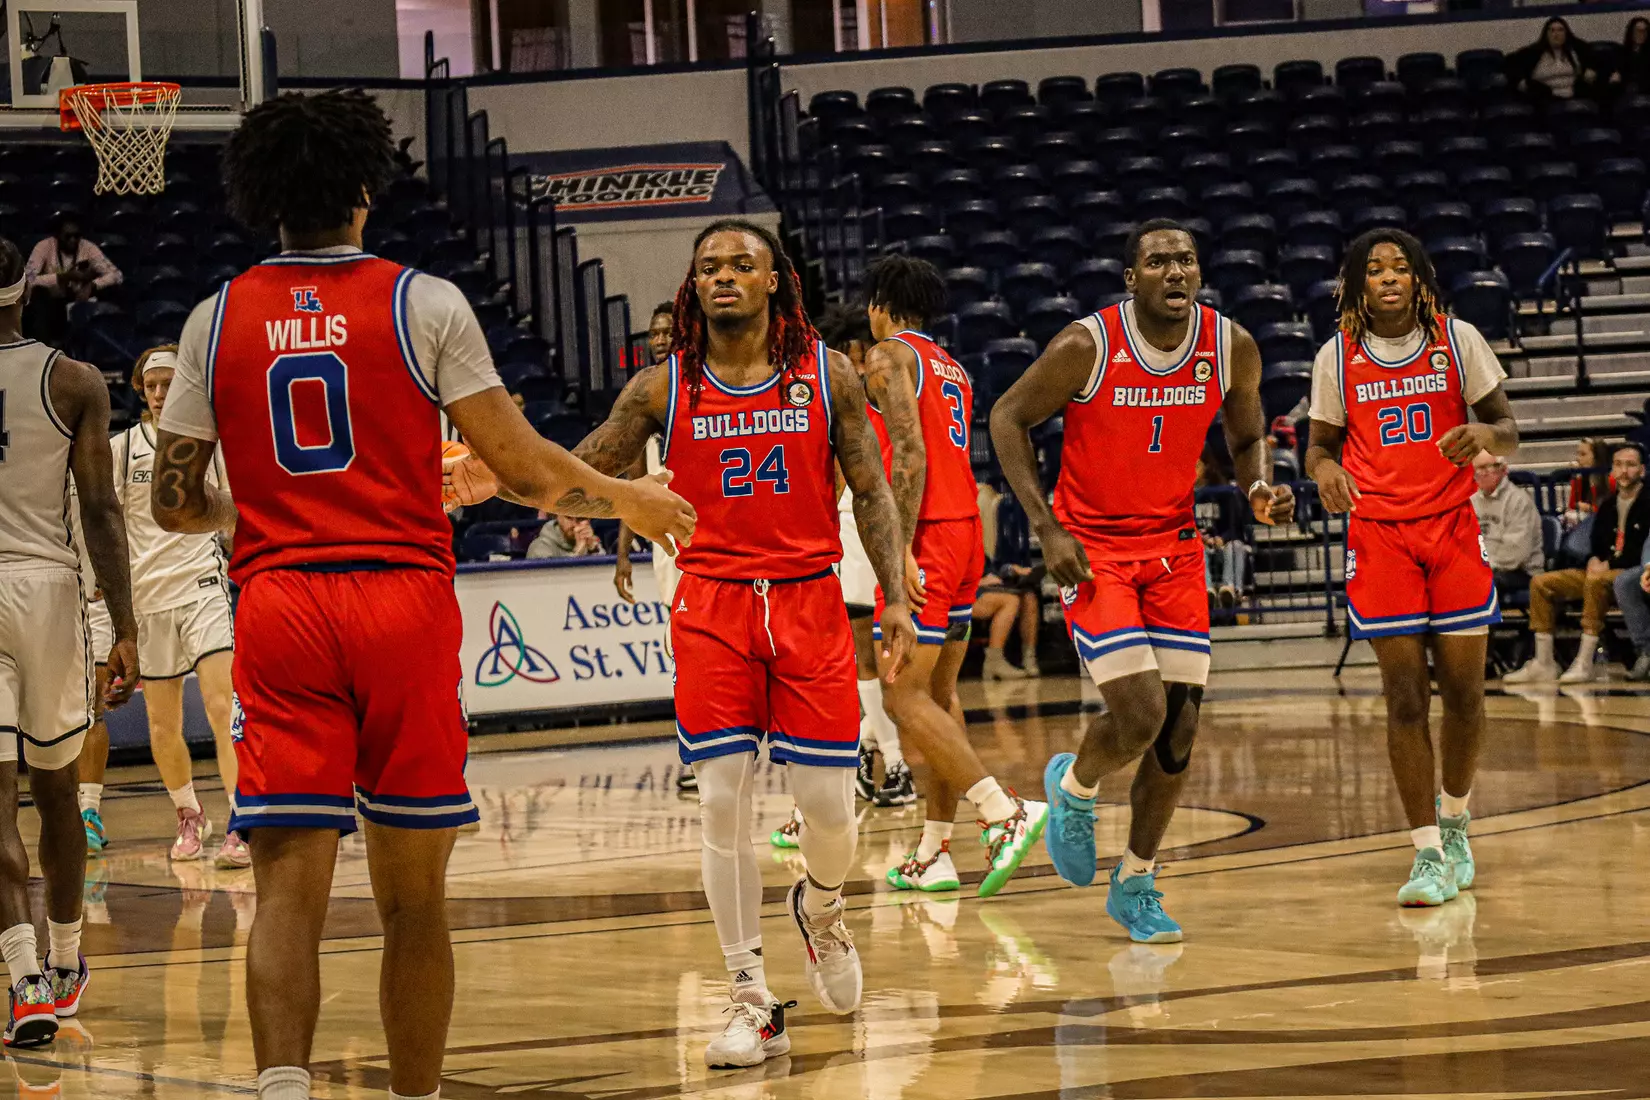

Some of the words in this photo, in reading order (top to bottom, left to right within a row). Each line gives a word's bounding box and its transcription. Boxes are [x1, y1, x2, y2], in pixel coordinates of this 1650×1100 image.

[265, 314, 348, 351] WILLIS
[1112, 384, 1207, 408] BULLDOGS
[1356, 371, 1449, 403] BULLDOGS
[266, 351, 356, 476] 0
[692, 408, 810, 440] BULLDOGS
[941, 379, 968, 452] 3
[1377, 401, 1433, 447] 20
[1147, 415, 1164, 453] 1
[719, 444, 790, 498] 24
